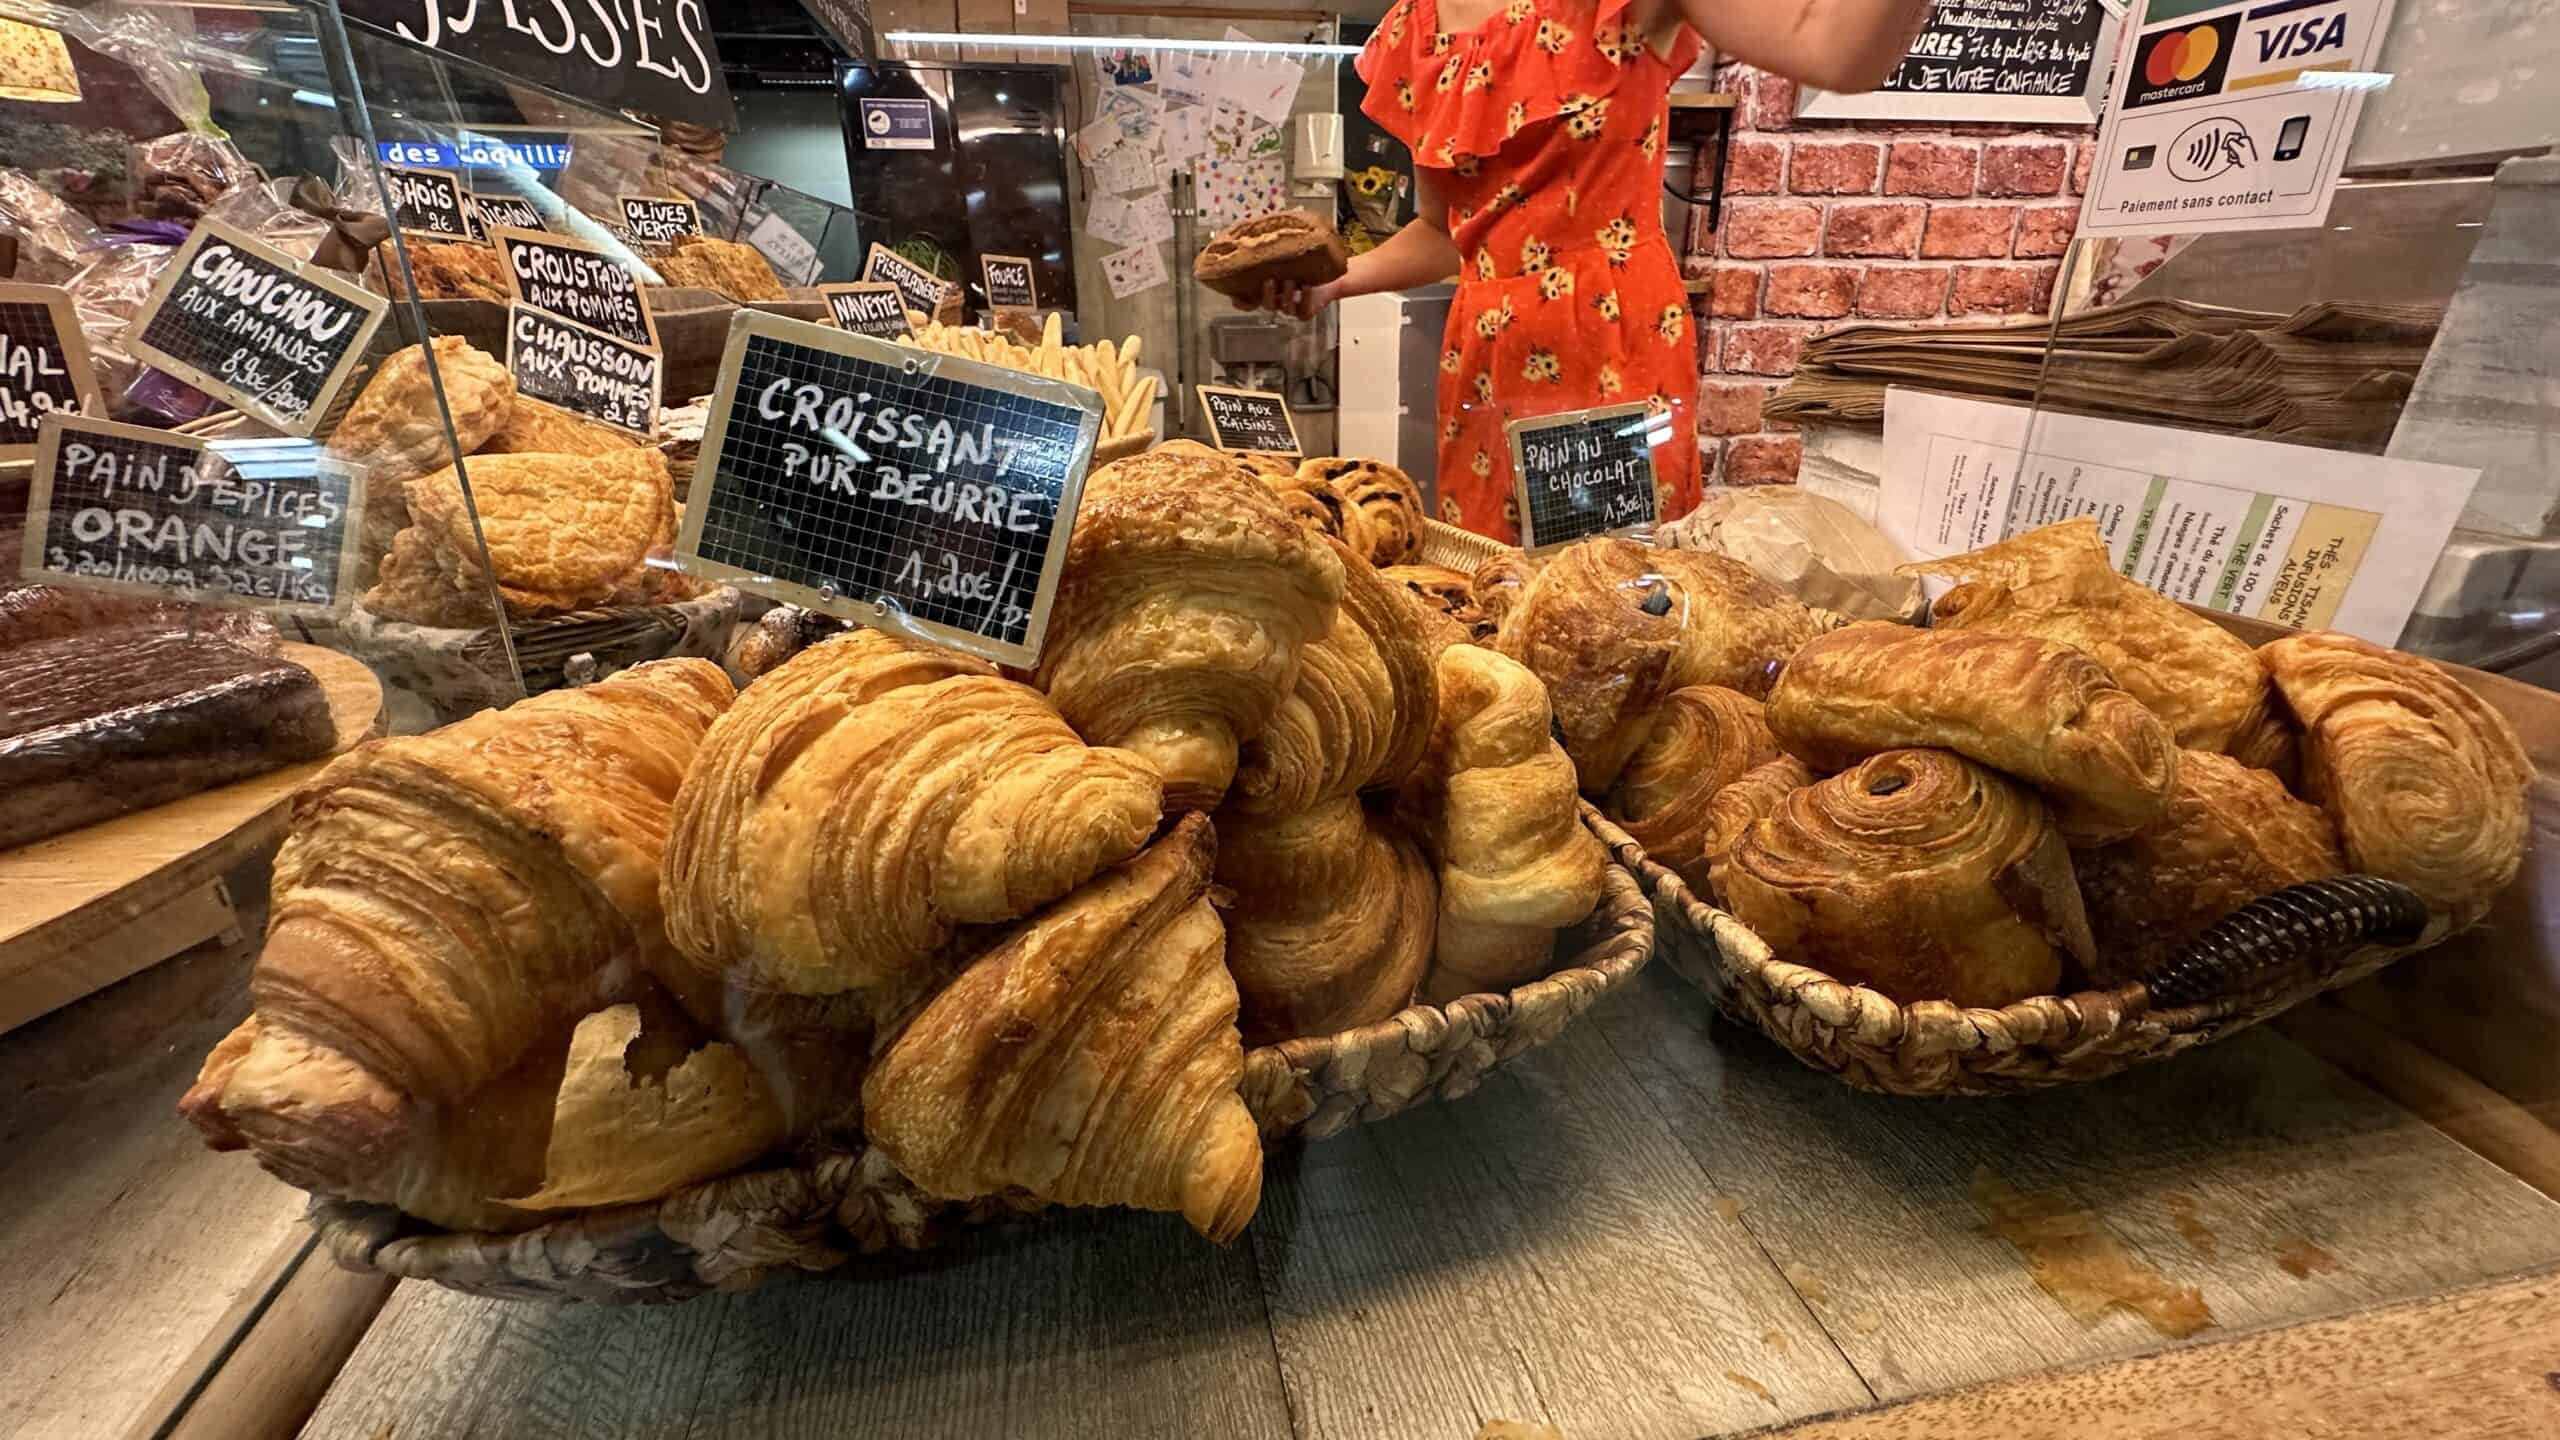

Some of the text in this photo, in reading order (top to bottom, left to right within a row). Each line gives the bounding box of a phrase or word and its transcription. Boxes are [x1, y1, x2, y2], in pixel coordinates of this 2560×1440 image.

[2256, 12, 2348, 64] VISA
[1947, 65, 1995, 91] VOTRE
[2139, 80, 2206, 104] mastercard
[388, 142, 440, 163] des
[2119, 189, 2274, 215] Paiement sans contact
[511, 245, 635, 301] CROUSTADE
[191, 245, 352, 342] CHOUCHOU
[530, 284, 638, 323] AUX POMMES
[833, 293, 900, 323] NAVETTE
[178, 285, 329, 374] AUX AMANDES
[515, 314, 655, 382] CHAUSSON
[520, 346, 650, 410] AUX POMMES
[1247, 403, 1272, 417] AUX
[1578, 435, 1601, 463] AU
[780, 441, 1045, 533] PUR BEURRE
[1549, 458, 1640, 499] CHOCOLAT
[71, 506, 309, 570] ORANGE
[2174, 511, 2197, 550] Nuages
[2208, 525, 2227, 548] Thé
[2260, 505, 2289, 551] Sachets
[2201, 549, 2216, 563] du
[2218, 542, 2250, 600] THÉ VERT
[2254, 554, 2268, 568] de
[2319, 536, 2344, 569] THÉS
[2186, 564, 2210, 601] dragon
[2243, 571, 2260, 593] 100
[2270, 558, 2298, 605] ALVEUS
[2278, 549, 2320, 621] INFUSIONS
